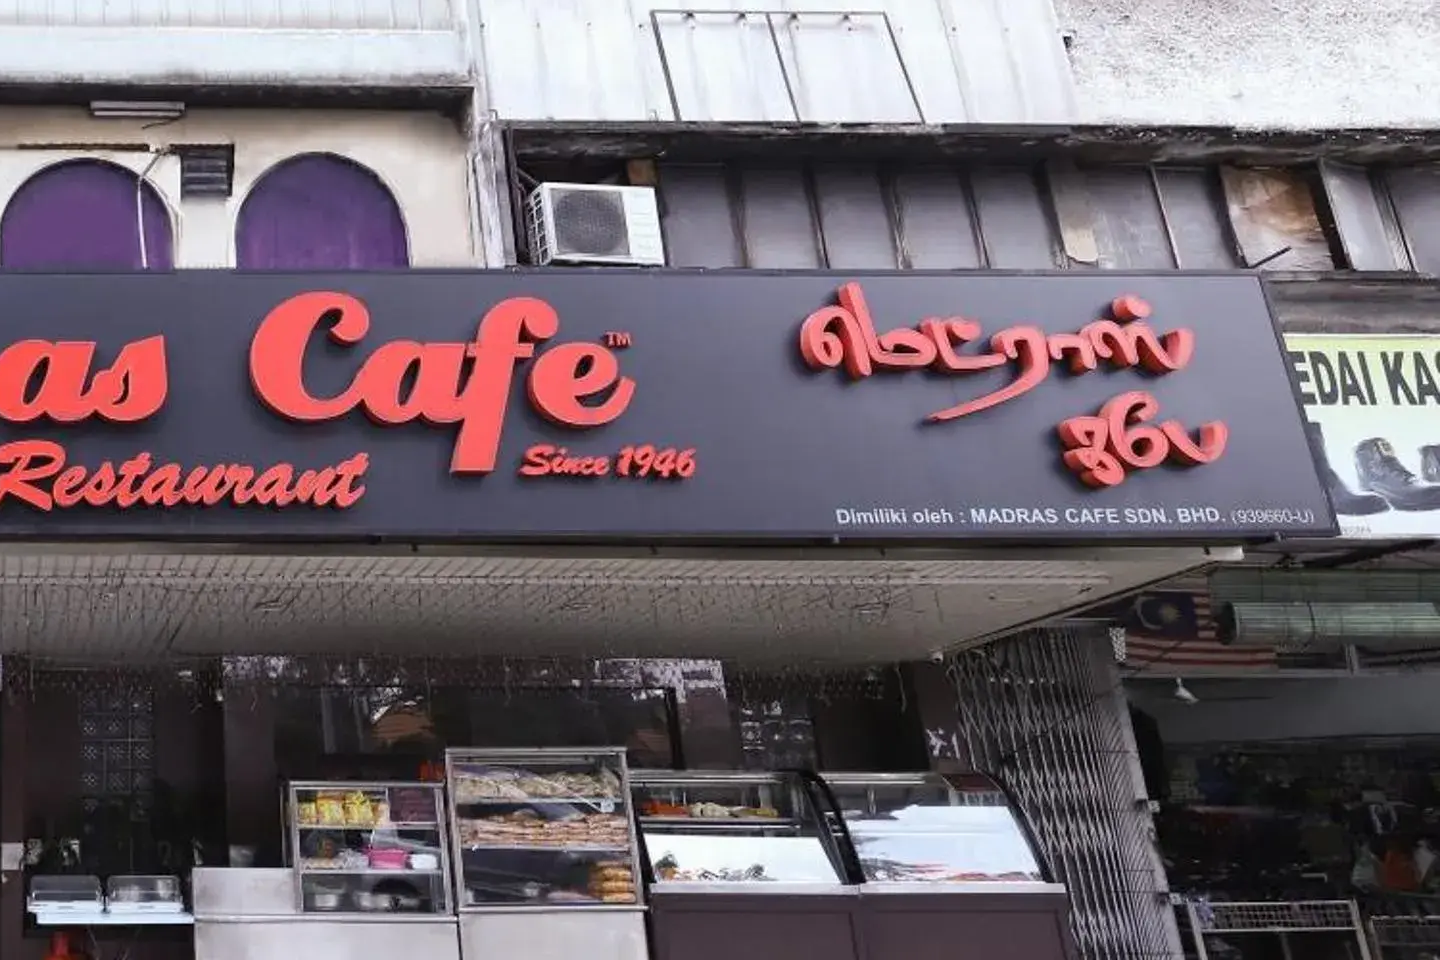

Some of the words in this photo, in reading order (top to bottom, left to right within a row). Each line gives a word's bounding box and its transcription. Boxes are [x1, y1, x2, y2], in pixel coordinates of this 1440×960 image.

[248, 290, 638, 475] Cafe
[518, 443, 611, 478] Since
[615, 445, 697, 479] 1946
[836, 508, 908, 525] Dimiliki
[911, 508, 955, 525] oleh
[970, 508, 1060, 524] MADRAS
[1064, 507, 1121, 524] CAFE
[1124, 507, 1173, 524] SDN.
[1177, 507, 1227, 524] BHD.
